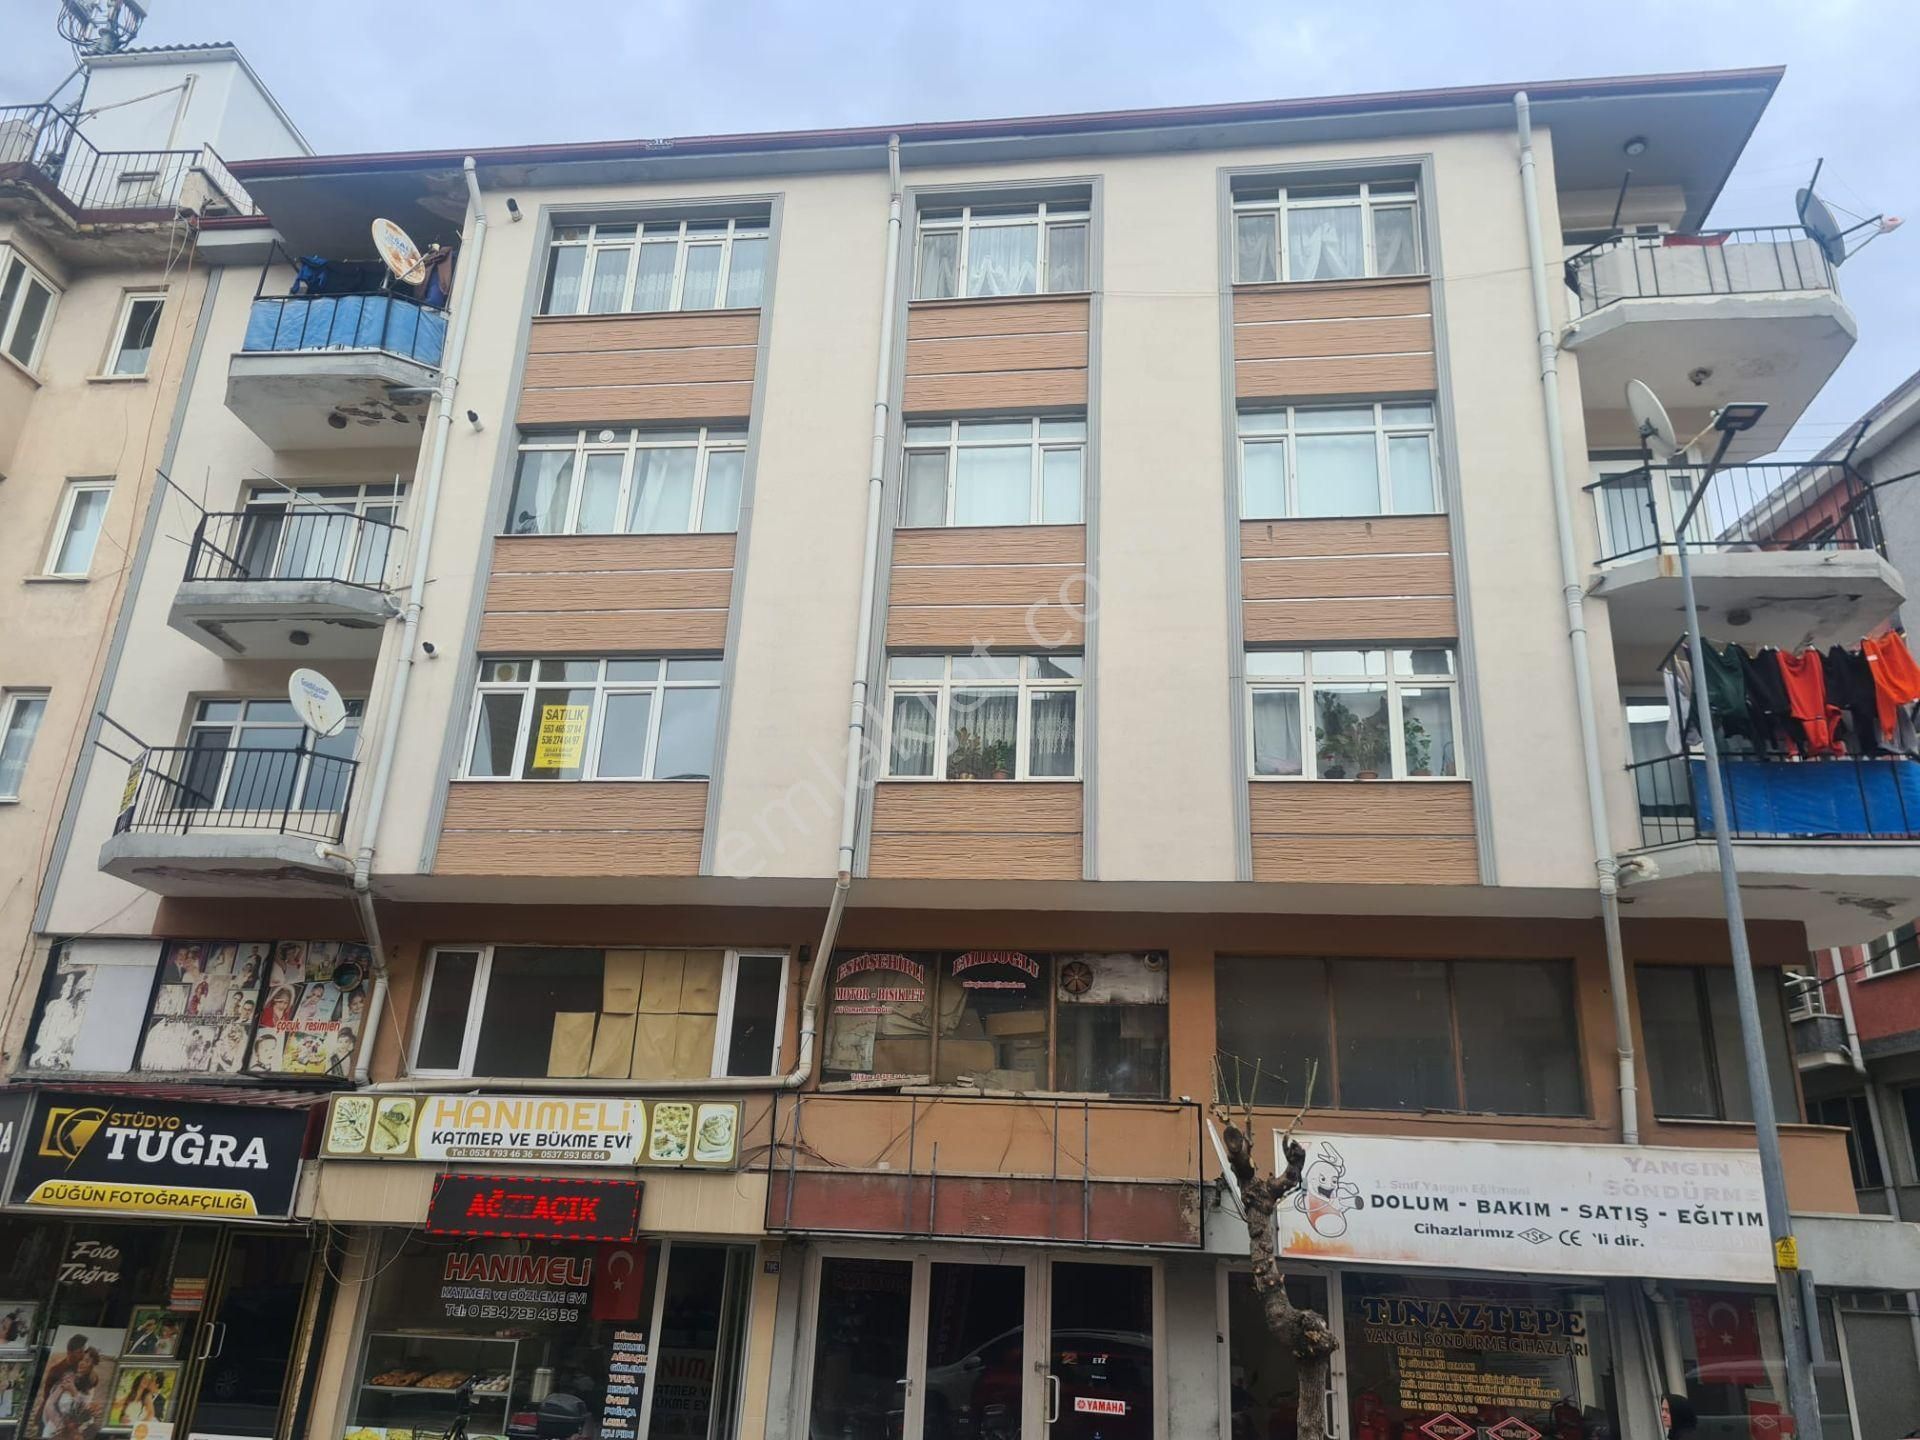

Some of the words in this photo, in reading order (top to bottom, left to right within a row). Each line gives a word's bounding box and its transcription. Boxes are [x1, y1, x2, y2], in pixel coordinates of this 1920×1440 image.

[545, 708, 584, 721] SATILIK
[834, 987, 870, 1001] MOTOR
[276, 1020, 299, 1034] çocuk
[109, 1111, 181, 1130] STÜDYO
[0, 1121, 14, 1153] A
[431, 1131, 504, 1147] KATMER
[509, 1132, 530, 1147] VE
[535, 1130, 597, 1148] BÜKME
[105, 1123, 269, 1170] TUĞRA
[452, 1148, 468, 1158] Tel:
[469, 1149, 491, 1159] 0534
[492, 1149, 510, 1159] 793
[511, 1150, 521, 1159] 46
[522, 1150, 533, 1159] 36
[540, 1150, 562, 1160] 0537
[563, 1151, 579, 1160] 593
[580, 1151, 592, 1161] 68
[594, 1151, 605, 1161] 64
[1623, 1156, 1730, 1178] YANGIN
[41, 1184, 105, 1202] DÜĞÜN
[109, 1188, 248, 1211] FOTOĞRAFÇILIĞI
[1602, 1176, 1761, 1203] SÖNDÜRME
[1371, 1195, 1449, 1212] DOLUM
[1477, 1199, 1552, 1218] BAKIM
[1579, 1204, 1648, 1229] SATIŞ
[1414, 1222, 1515, 1240] Cihazlarımız
[1614, 1234, 1645, 1247] dir.
[71, 1240, 119, 1260] Foto
[58, 1262, 120, 1286] Tuğra
[441, 1286, 492, 1301] KATMER
[493, 1290, 507, 1301] ve
[508, 1286, 565, 1304] GÖZLEME
[481, 1305, 508, 1319] 534
[508, 1306, 537, 1320] 793
[538, 1308, 557, 1322] 46
[558, 1308, 578, 1323] 36
[1361, 1297, 1586, 1338] TINAZTEPE
[1364, 1328, 1421, 1346] YANGIN
[655, 1383, 697, 1397] ATMER
[655, 1397, 690, 1410] ÜKME
[1086, 1399, 1124, 1414] YAMAHA
